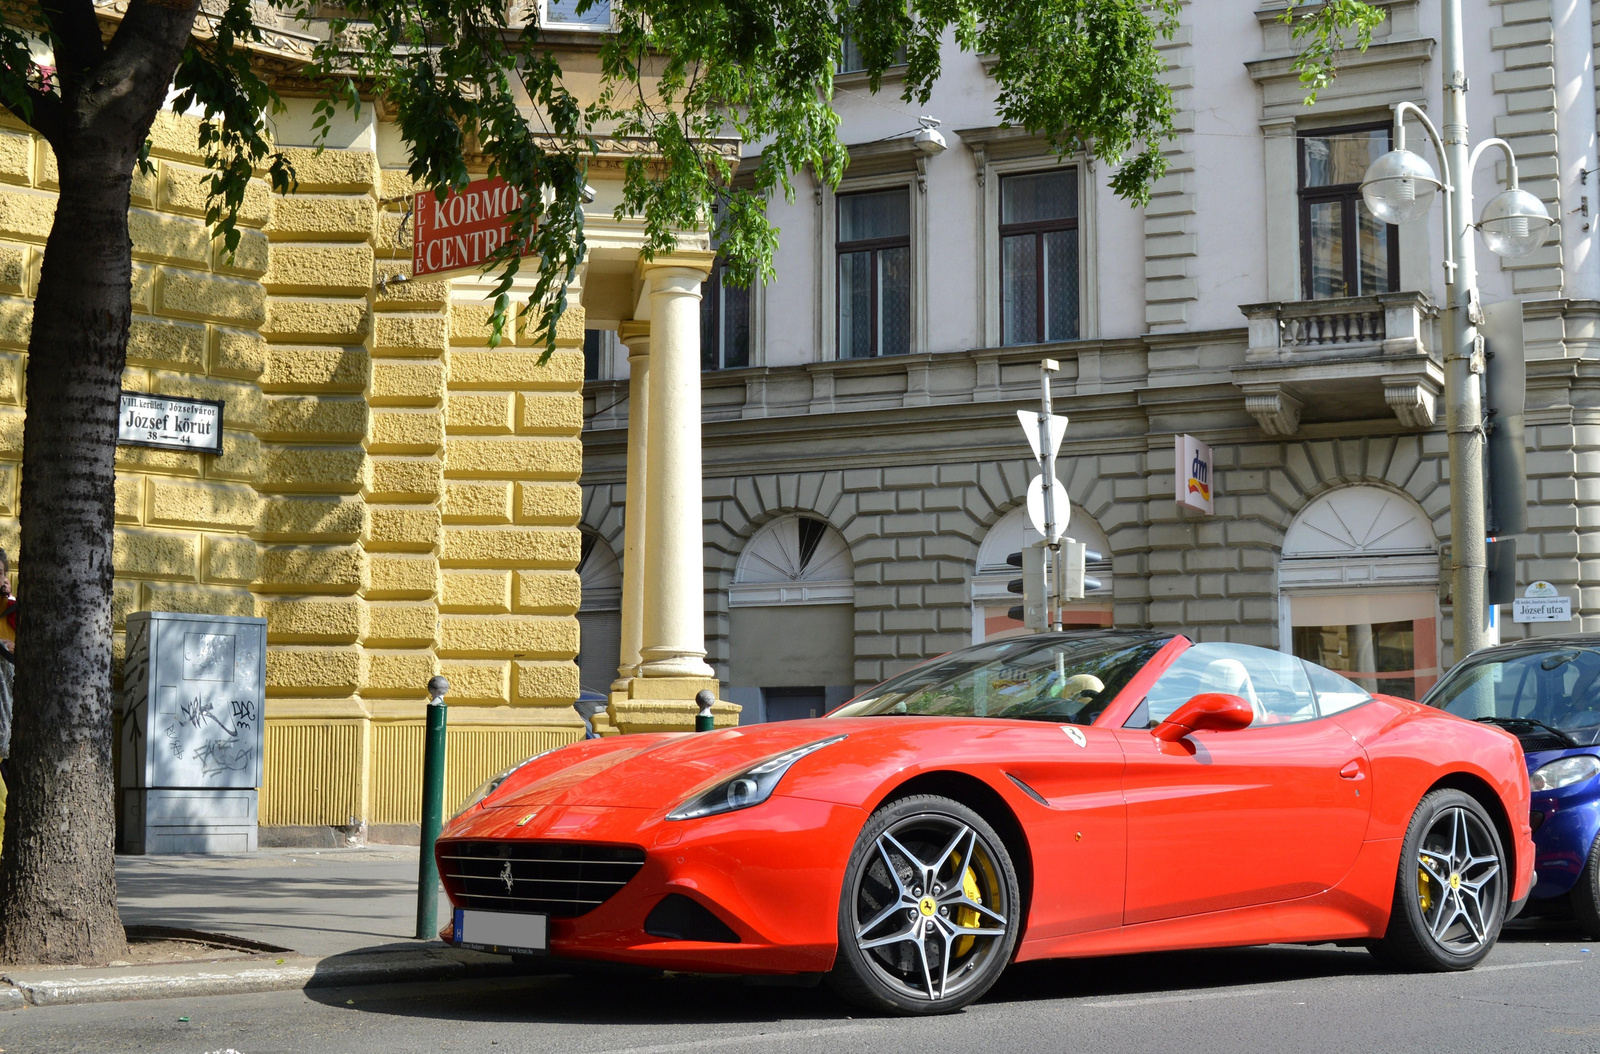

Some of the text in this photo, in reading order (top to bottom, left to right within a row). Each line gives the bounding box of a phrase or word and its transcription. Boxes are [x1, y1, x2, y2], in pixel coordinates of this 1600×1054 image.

[415, 194, 426, 274] ELITE
[122, 397, 216, 416] VIII. kerület, Józsefváros
[126, 410, 211, 435] József körút
[147, 431, 191, 444] 38 44
[1192, 449, 1207, 483] dm
[1520, 605, 1563, 614] József utca
[456, 928, 461, 938] H
